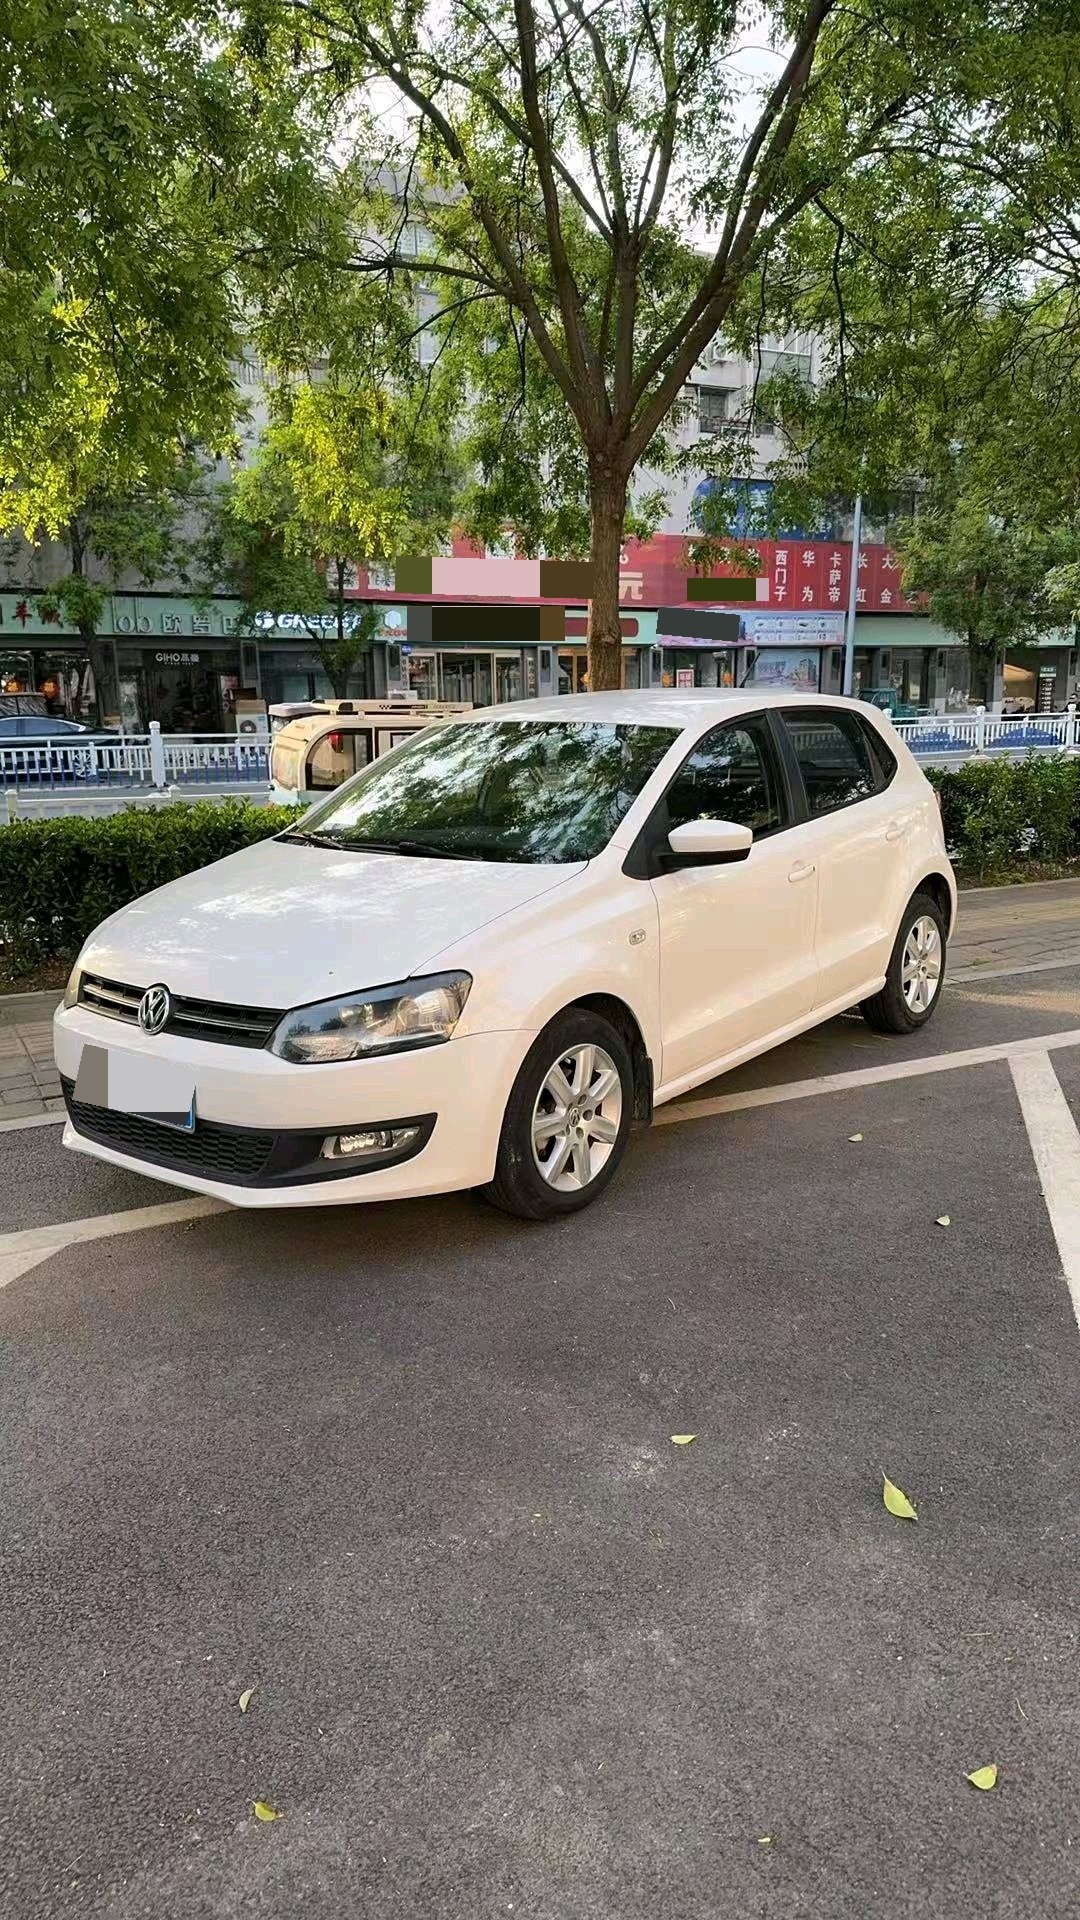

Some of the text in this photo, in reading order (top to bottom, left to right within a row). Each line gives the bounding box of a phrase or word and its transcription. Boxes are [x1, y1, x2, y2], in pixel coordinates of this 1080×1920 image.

[774, 550, 788, 602] 西门子
[801, 550, 815, 602] 华为
[828, 552, 842, 603] 卡萨帝
[855, 553, 868, 604] 长虹
[880, 553, 894, 604] 大金
